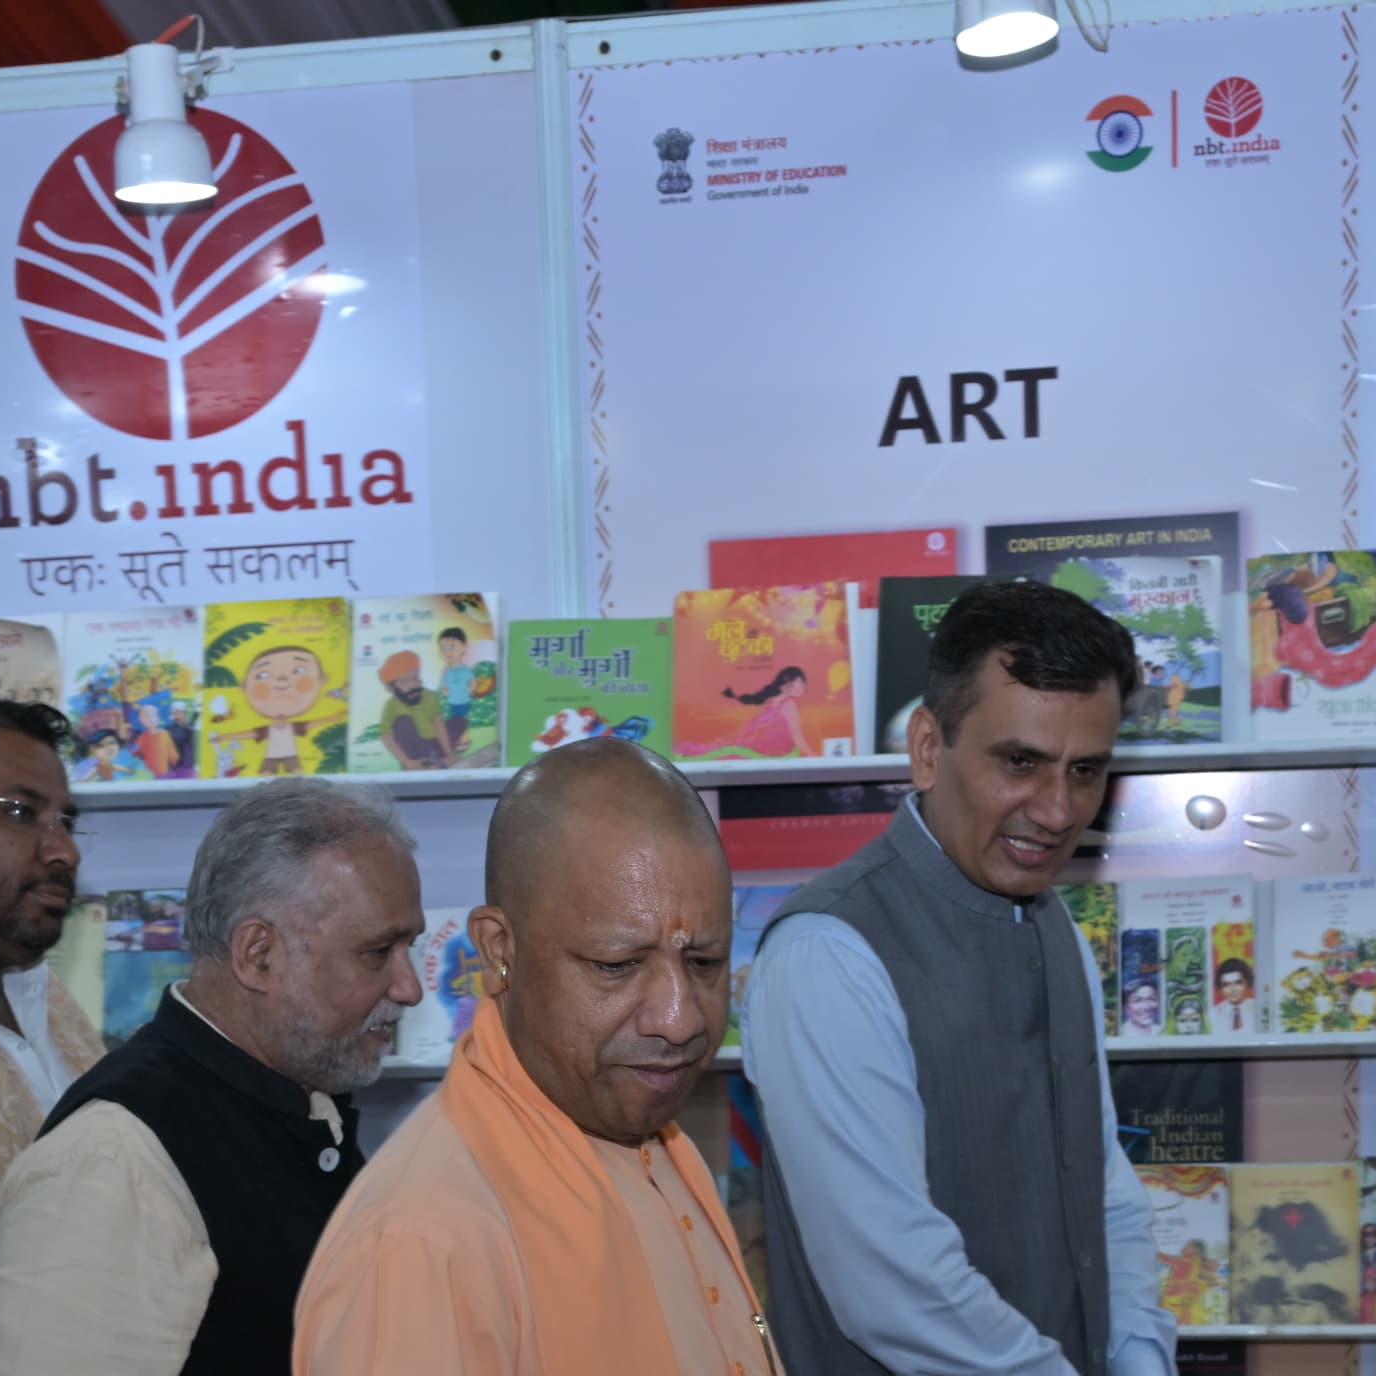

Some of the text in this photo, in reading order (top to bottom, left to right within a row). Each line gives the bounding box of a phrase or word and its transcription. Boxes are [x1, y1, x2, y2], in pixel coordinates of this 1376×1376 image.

[707, 165, 847, 186] MINISTRY OF EDUCATION
[707, 184, 810, 201] Government of India
[878, 366, 1059, 447] ART
[1008, 527, 1213, 554] CONTEMPORARY ART IN INDIA
[118, 532, 191, 604] सूते
[206, 537, 362, 594] सकलम्
[1128, 1105, 1224, 1126] Traditional
[1157, 1125, 1224, 1143] Indian
